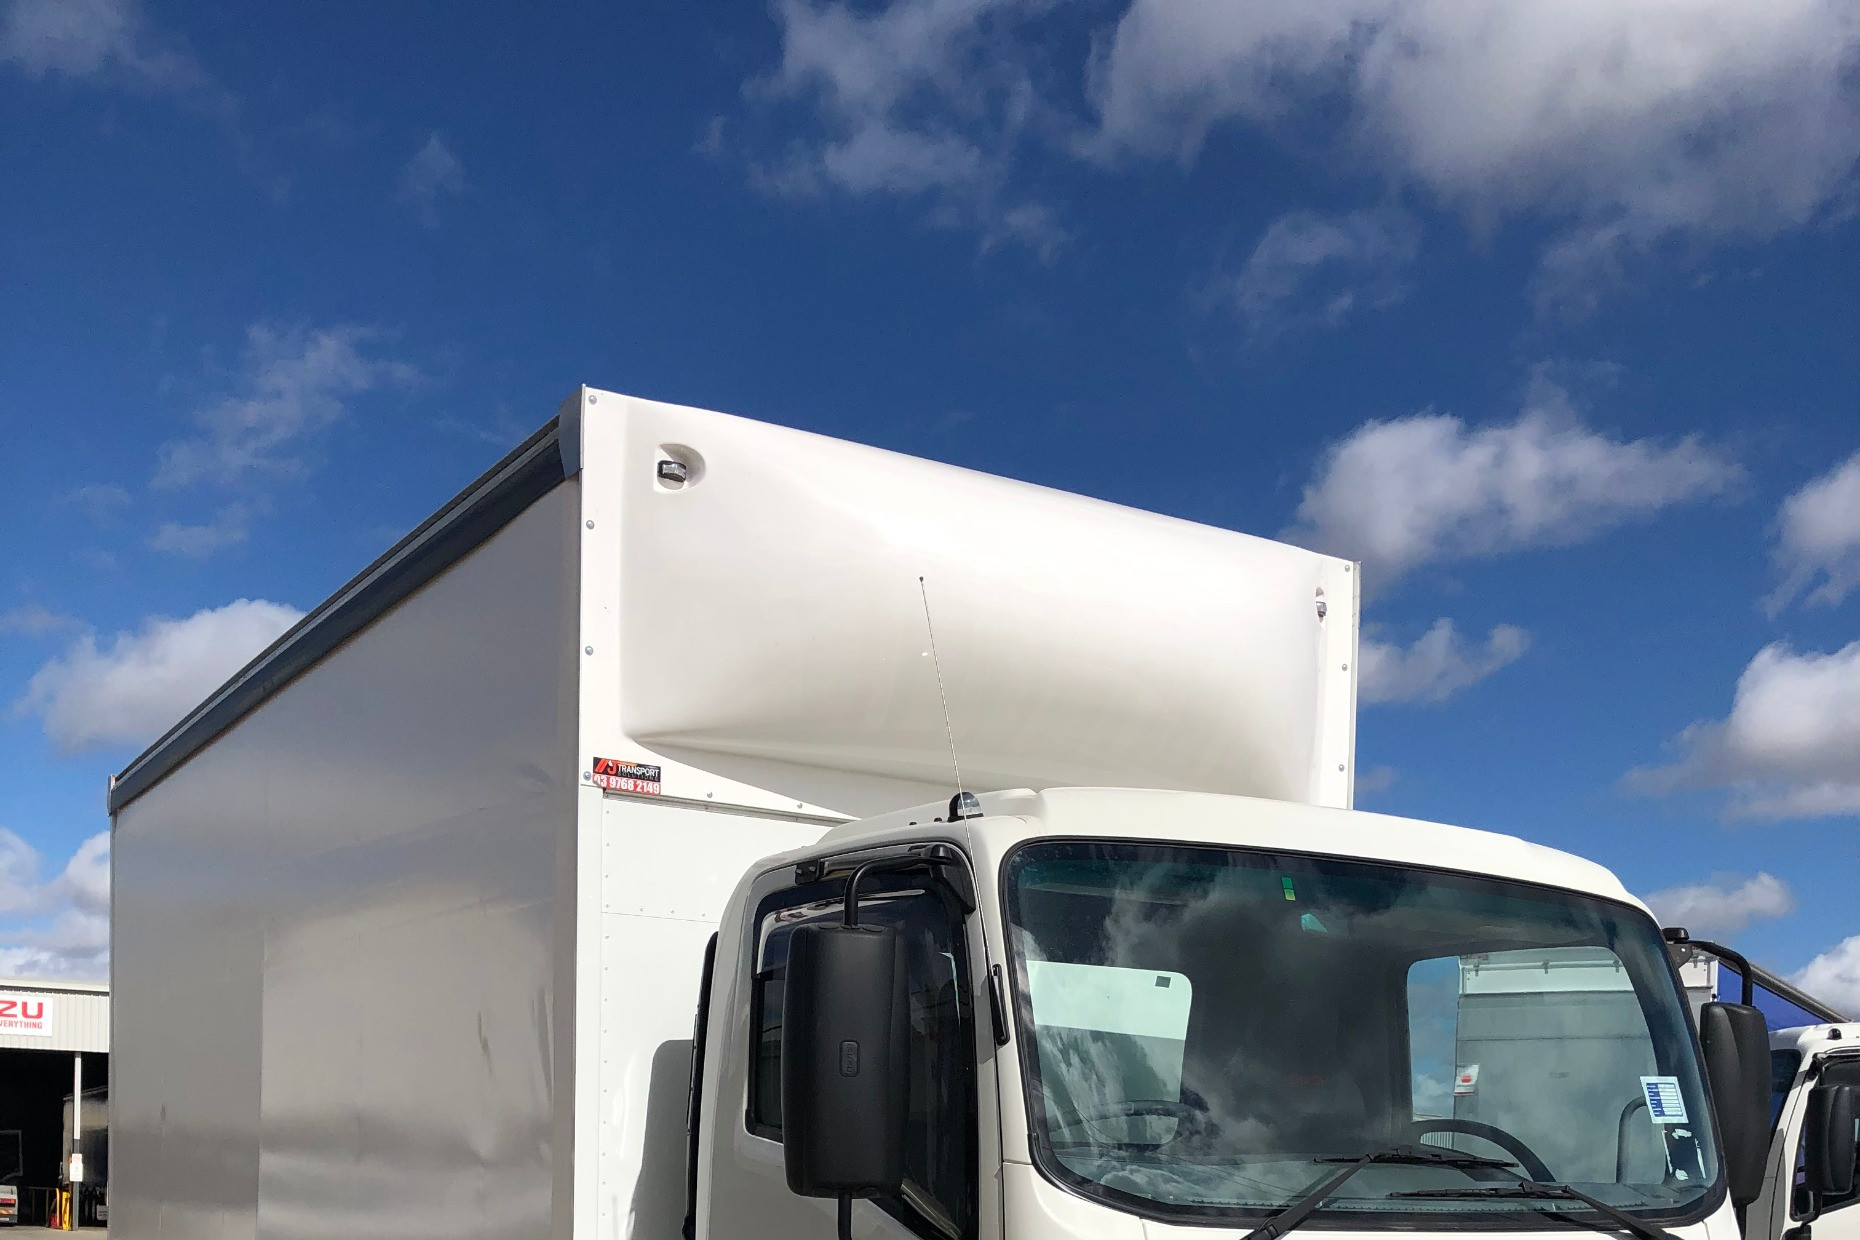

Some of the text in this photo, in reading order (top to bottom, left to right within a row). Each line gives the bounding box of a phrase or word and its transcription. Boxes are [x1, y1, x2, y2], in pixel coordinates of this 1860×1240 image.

[618, 764, 660, 777] TRANSPORT
[609, 776, 634, 790] 9768
[635, 781, 660, 794] 2149
